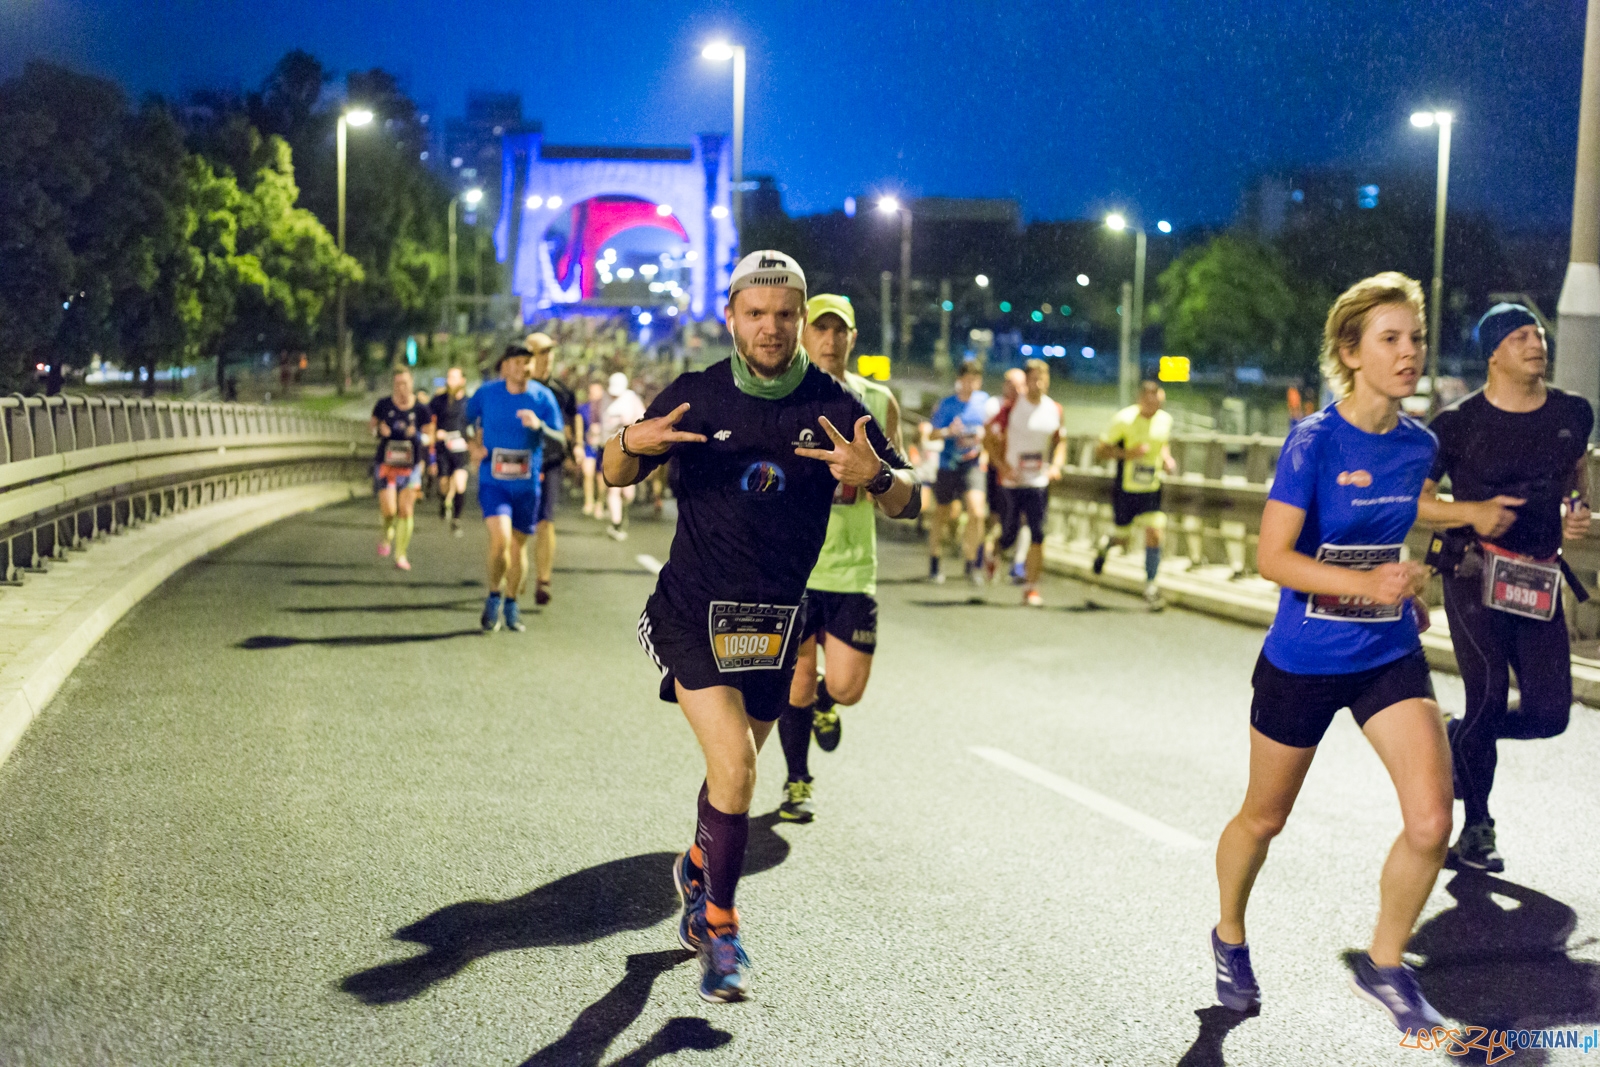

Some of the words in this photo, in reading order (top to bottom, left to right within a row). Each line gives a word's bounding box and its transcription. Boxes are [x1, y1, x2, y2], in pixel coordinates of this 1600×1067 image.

[713, 429, 732, 441] 4F
[1505, 584, 1538, 607] 5930
[723, 635, 770, 656] 10909
